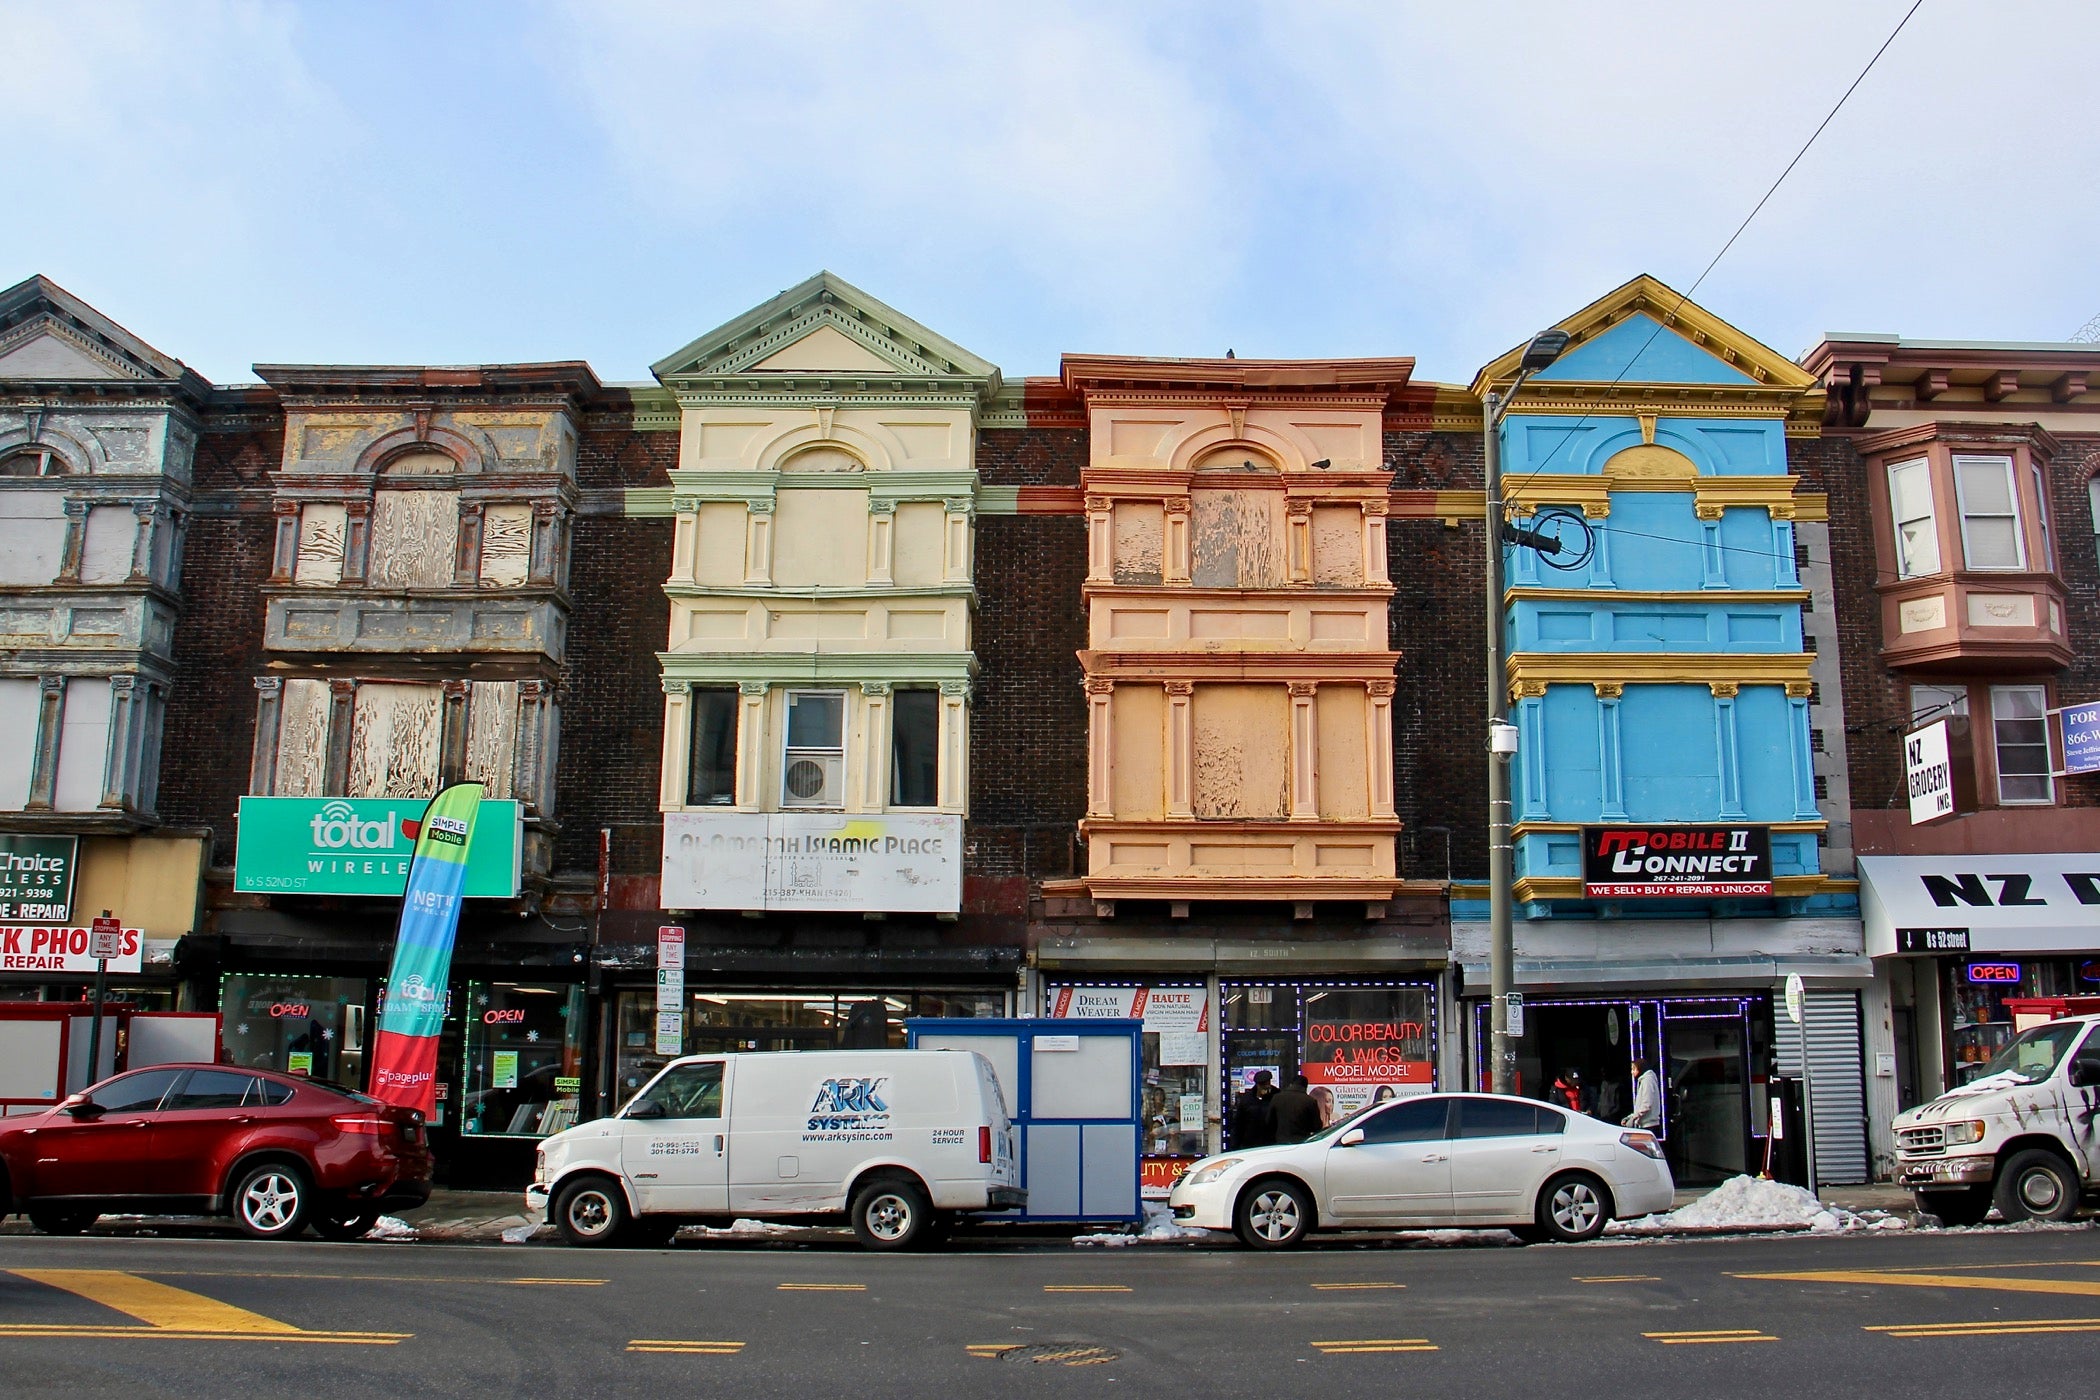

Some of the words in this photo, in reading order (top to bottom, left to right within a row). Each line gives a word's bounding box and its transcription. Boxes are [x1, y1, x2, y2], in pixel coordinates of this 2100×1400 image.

[2069, 710, 2098, 725] FOR
[1908, 738, 1922, 767] NZ
[1909, 761, 1948, 799] GROCERY
[1936, 793, 1951, 812] INC.
[310, 811, 396, 848] total
[432, 817, 465, 832] SIMPLE
[431, 830, 462, 844] Mobile
[1598, 831, 1726, 857] MOBILE
[1729, 831, 1749, 851] II
[885, 836, 942, 854] PLACE
[0, 853, 64, 871] Choice
[1611, 845, 1758, 873] CONNECT
[308, 861, 407, 874] WIRELE
[245, 877, 254, 886] 16
[256, 877, 263, 886] S
[265, 877, 292, 887] 52ND
[295, 878, 308, 888] ST
[26, 888, 53, 898] 9398
[1591, 887, 1610, 895] WE
[1614, 886, 1636, 895] SELL
[1645, 886, 1667, 894] BUY
[1676, 886, 1713, 894] REPAIR
[1722, 885, 1767, 893] UNLOCK
[1920, 874, 2048, 906] NZ
[20, 903, 66, 918] REPAIR
[0, 928, 23, 954] K
[31, 928, 138, 956] PHOS
[1926, 931, 1931, 948] 8
[1932, 934, 1937, 948] s
[1938, 931, 1946, 948] 52
[1946, 932, 1967, 948] street
[1264, 949, 1288, 957] SOUTH
[4, 956, 64, 969] REPAIR
[660, 971, 665, 983] 2
[1972, 966, 2017, 980] OPEN
[1079, 995, 1118, 1006] DREAM
[1152, 994, 1190, 1003] HAUTE
[1253, 990, 1271, 1002] EXIT
[270, 1004, 310, 1018] OPEN
[484, 1009, 525, 1024] OPEN
[1076, 1007, 1120, 1017] WEAVER
[1309, 1024, 1362, 1042] COLOR
[1364, 1022, 1423, 1040] BEAUTY
[1334, 1047, 1345, 1064] &
[1351, 1046, 1402, 1063] WIGS
[1324, 1065, 1364, 1076] MODEL
[1367, 1064, 1409, 1076] MODEL
[388, 1071, 432, 1085] pageplu
[810, 1077, 889, 1113] ARK
[1183, 1103, 1200, 1111] CBD
[802, 1132, 893, 1143] www.arksysinc.com
[1172, 1163, 1183, 1176] &
